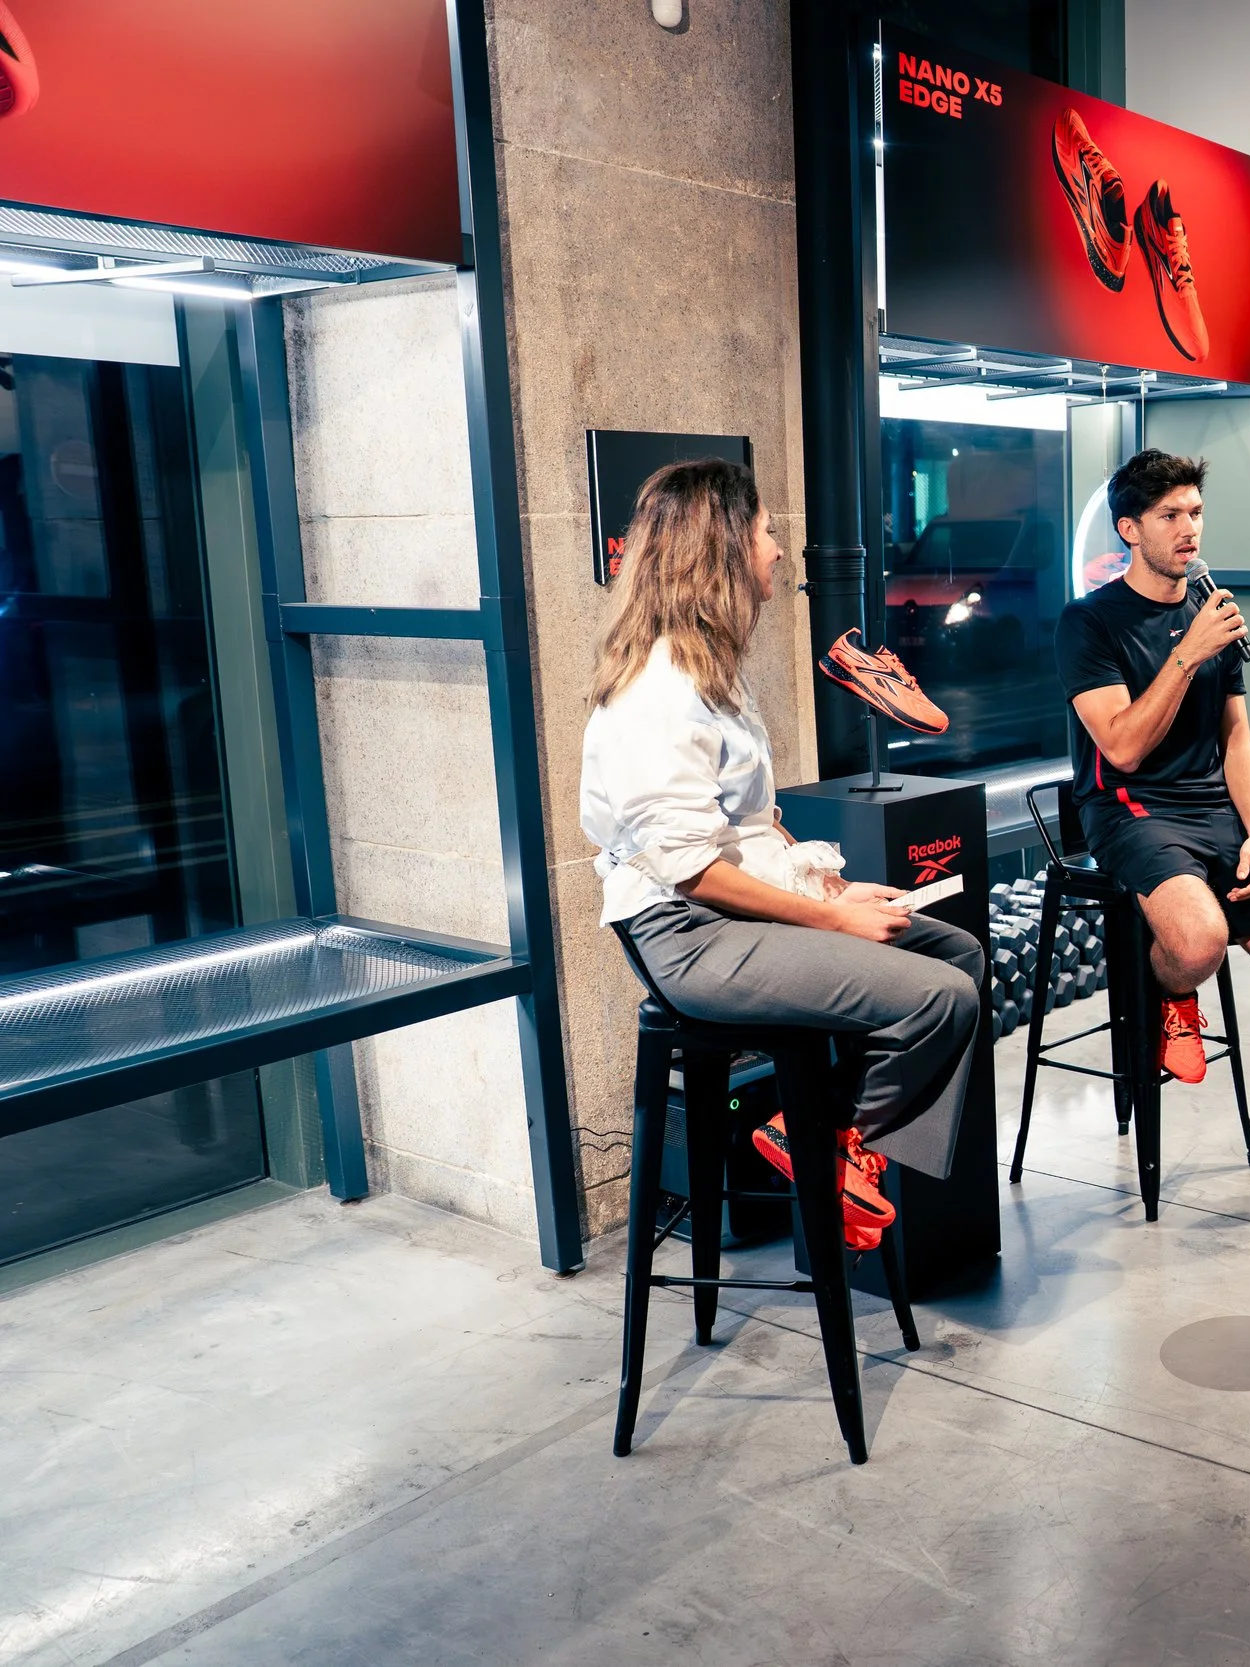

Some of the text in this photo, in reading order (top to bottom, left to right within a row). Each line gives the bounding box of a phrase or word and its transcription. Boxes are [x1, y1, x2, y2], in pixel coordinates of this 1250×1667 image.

[899, 51, 1003, 107] NANO X5
[899, 79, 962, 120] EDGE
[908, 834, 962, 862] Reebok
